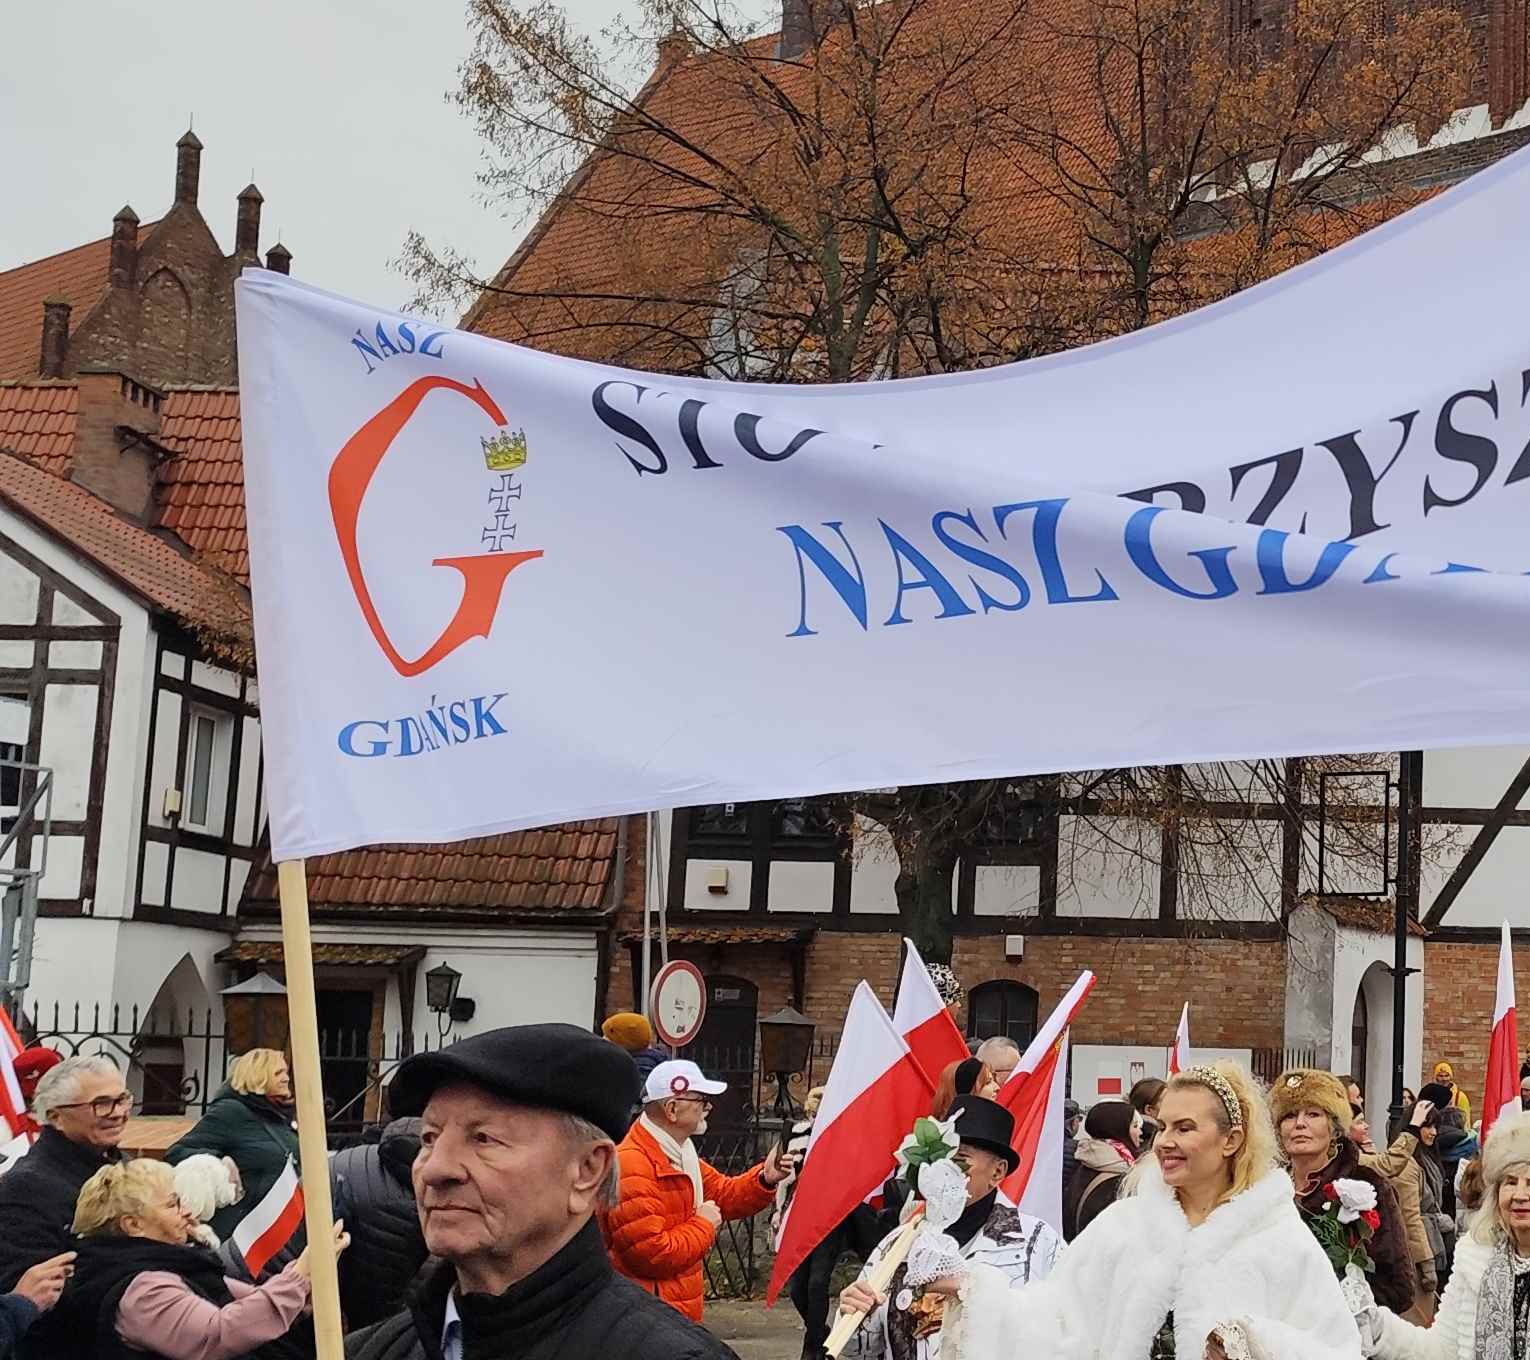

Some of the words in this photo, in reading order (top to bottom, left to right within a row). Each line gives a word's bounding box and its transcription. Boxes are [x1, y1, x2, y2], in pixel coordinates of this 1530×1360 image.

[351, 320, 452, 375] NASZ
[786, 497, 1120, 638] NASZ
[338, 693, 509, 758] GDAŃSK
